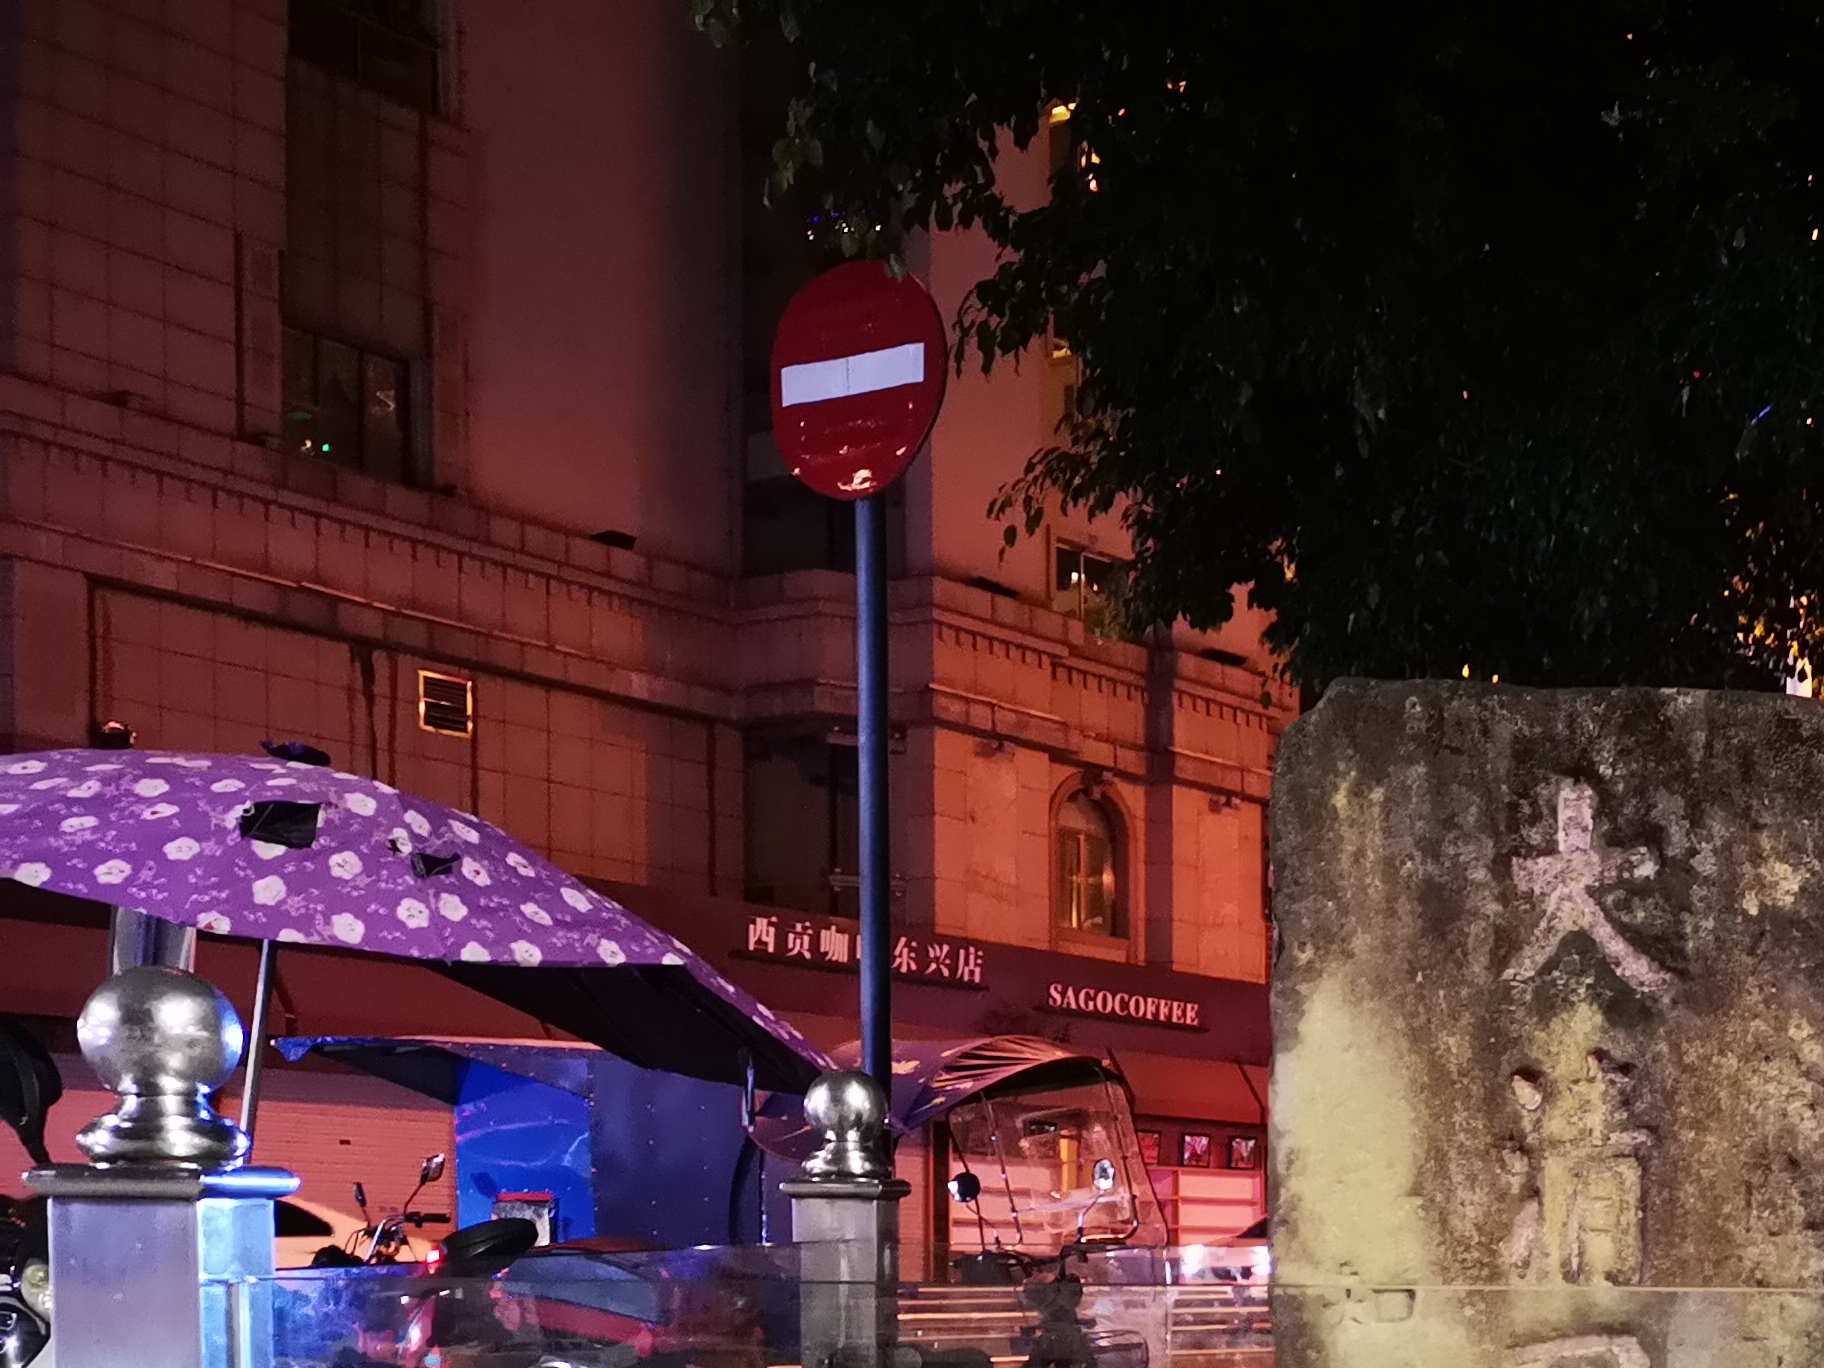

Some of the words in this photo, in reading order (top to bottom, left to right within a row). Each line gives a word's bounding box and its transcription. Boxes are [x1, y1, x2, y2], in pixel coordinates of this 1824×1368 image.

[748, 916, 985, 985] 西贡咖东兴店
[1048, 983, 1200, 1027] SAGOCOFFEE
